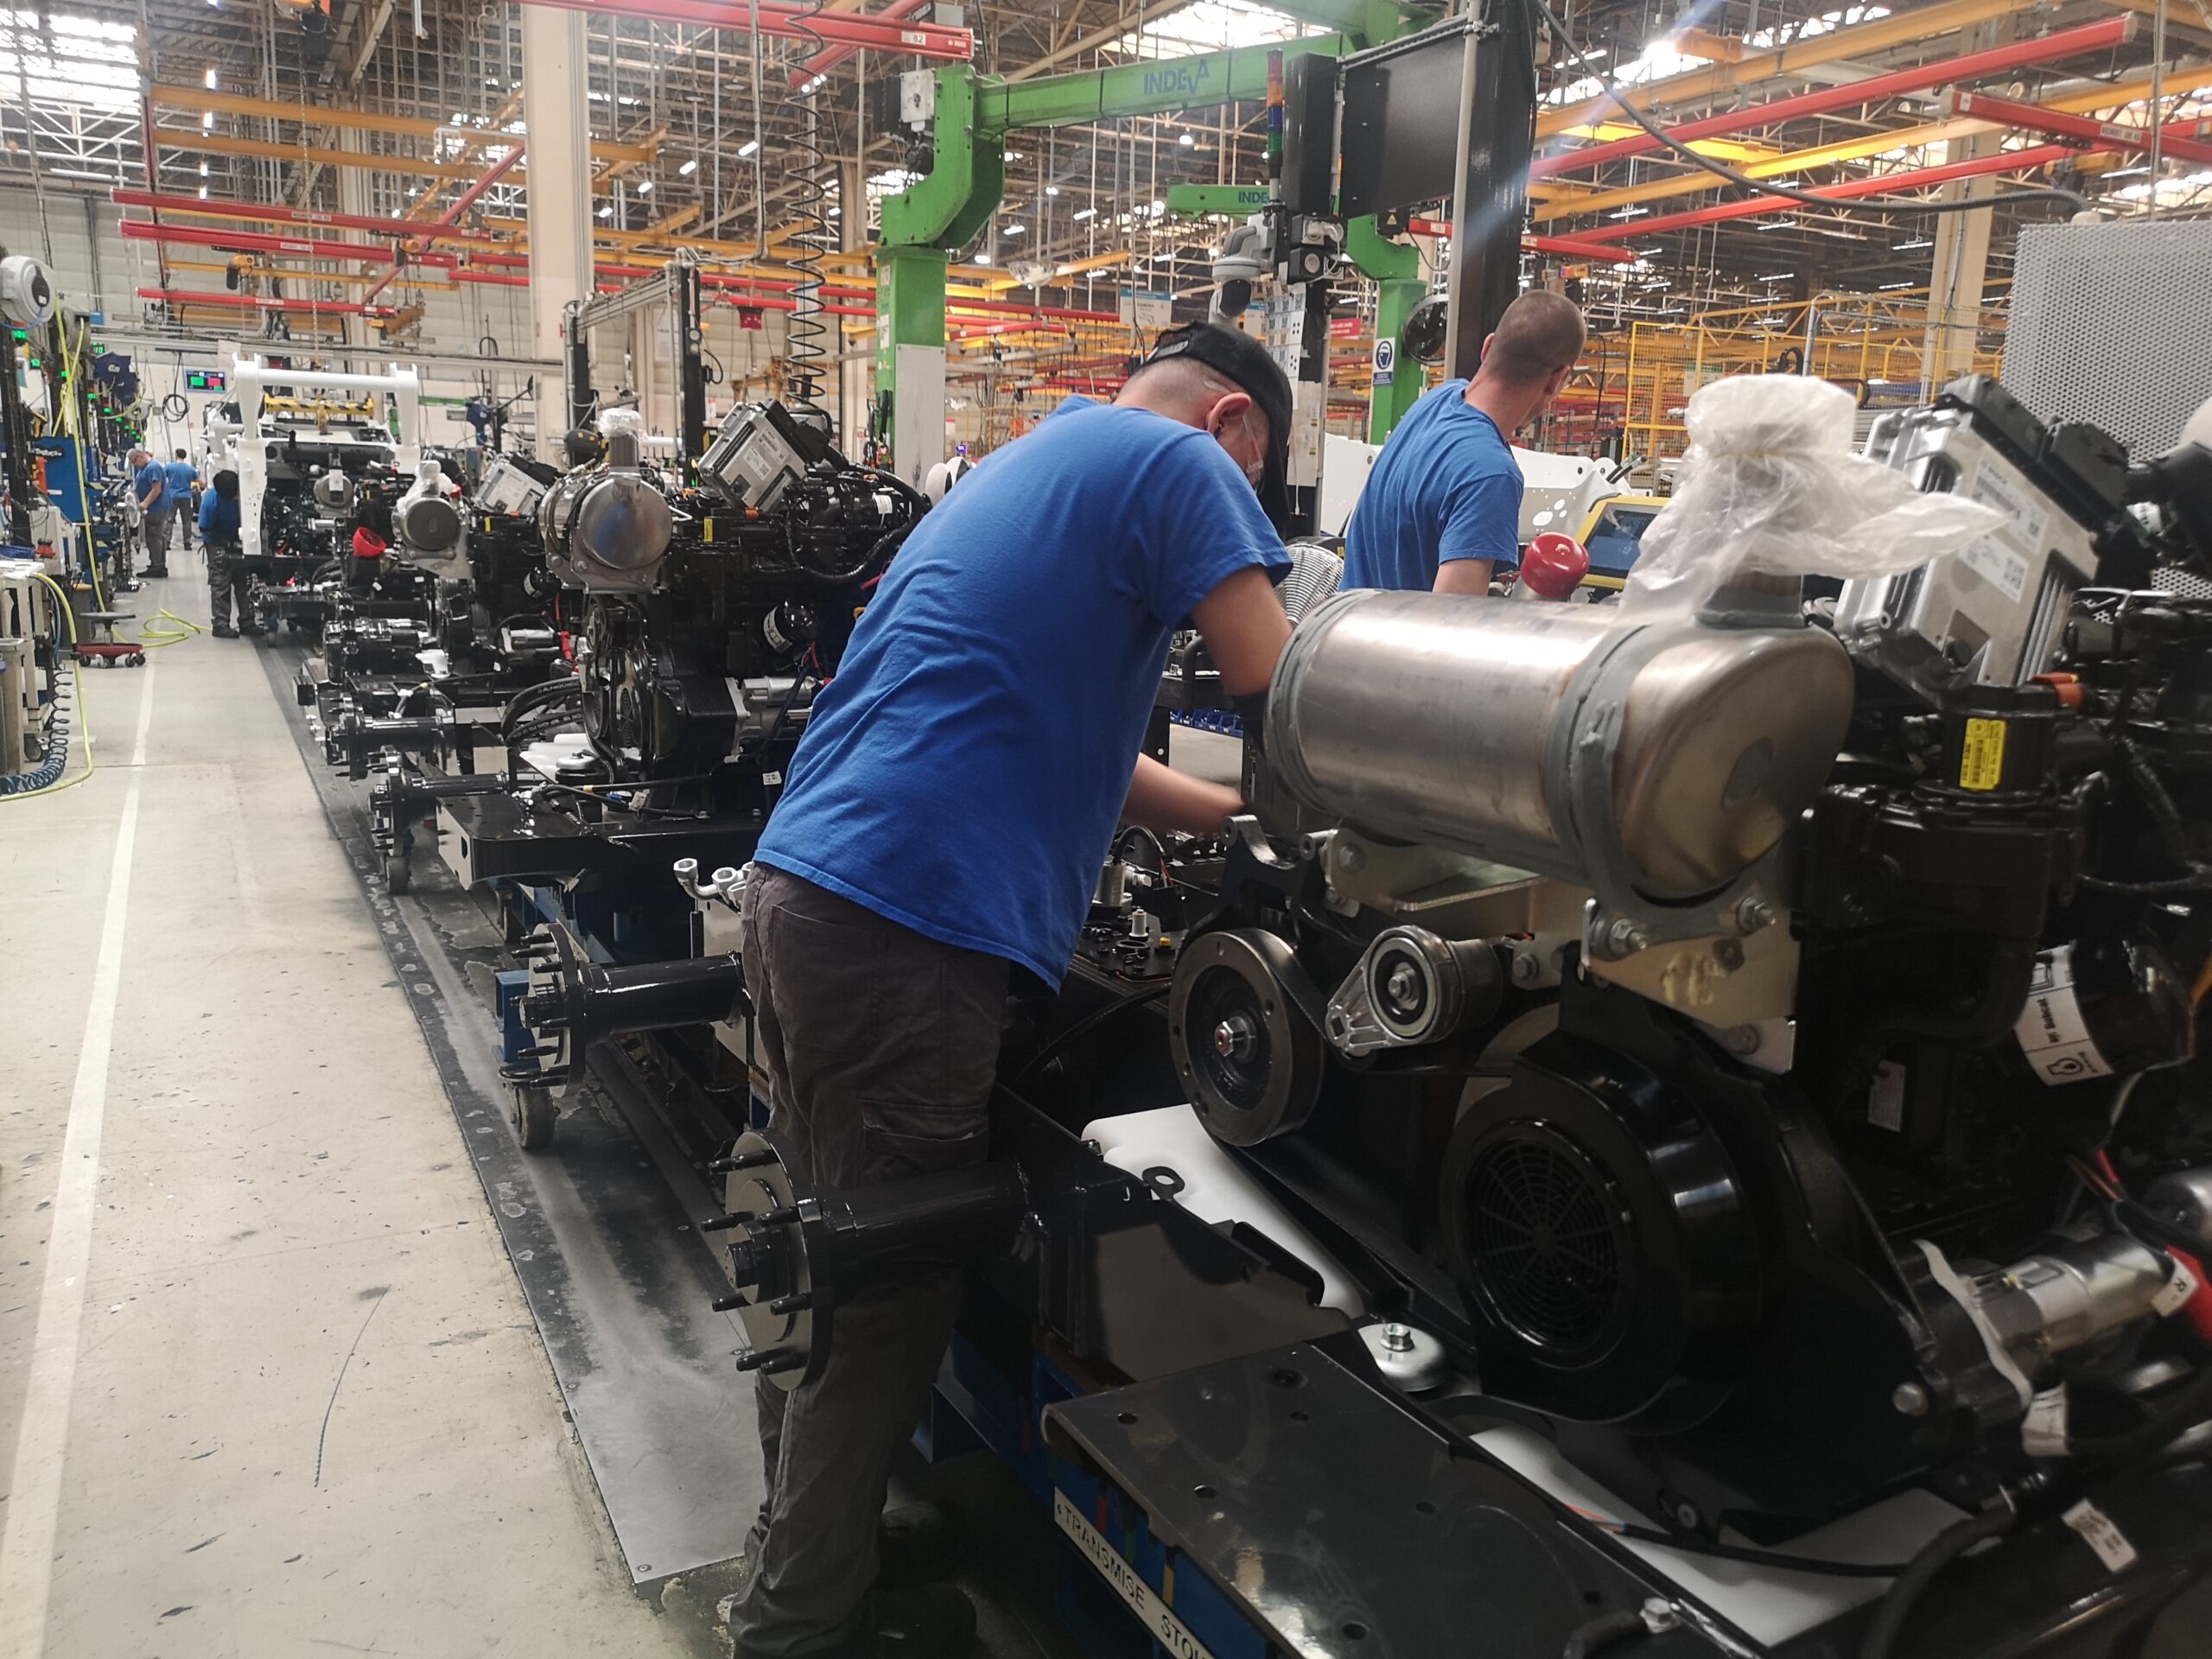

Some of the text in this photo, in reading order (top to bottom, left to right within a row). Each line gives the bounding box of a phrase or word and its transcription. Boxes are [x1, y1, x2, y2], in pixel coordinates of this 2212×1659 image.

[1144, 59, 1210, 95] INDEVA
[1238, 191, 1268, 204] INDE
[2037, 998, 2056, 1029] Bobcat
[1064, 1504, 1145, 1610] TRANSMISE
